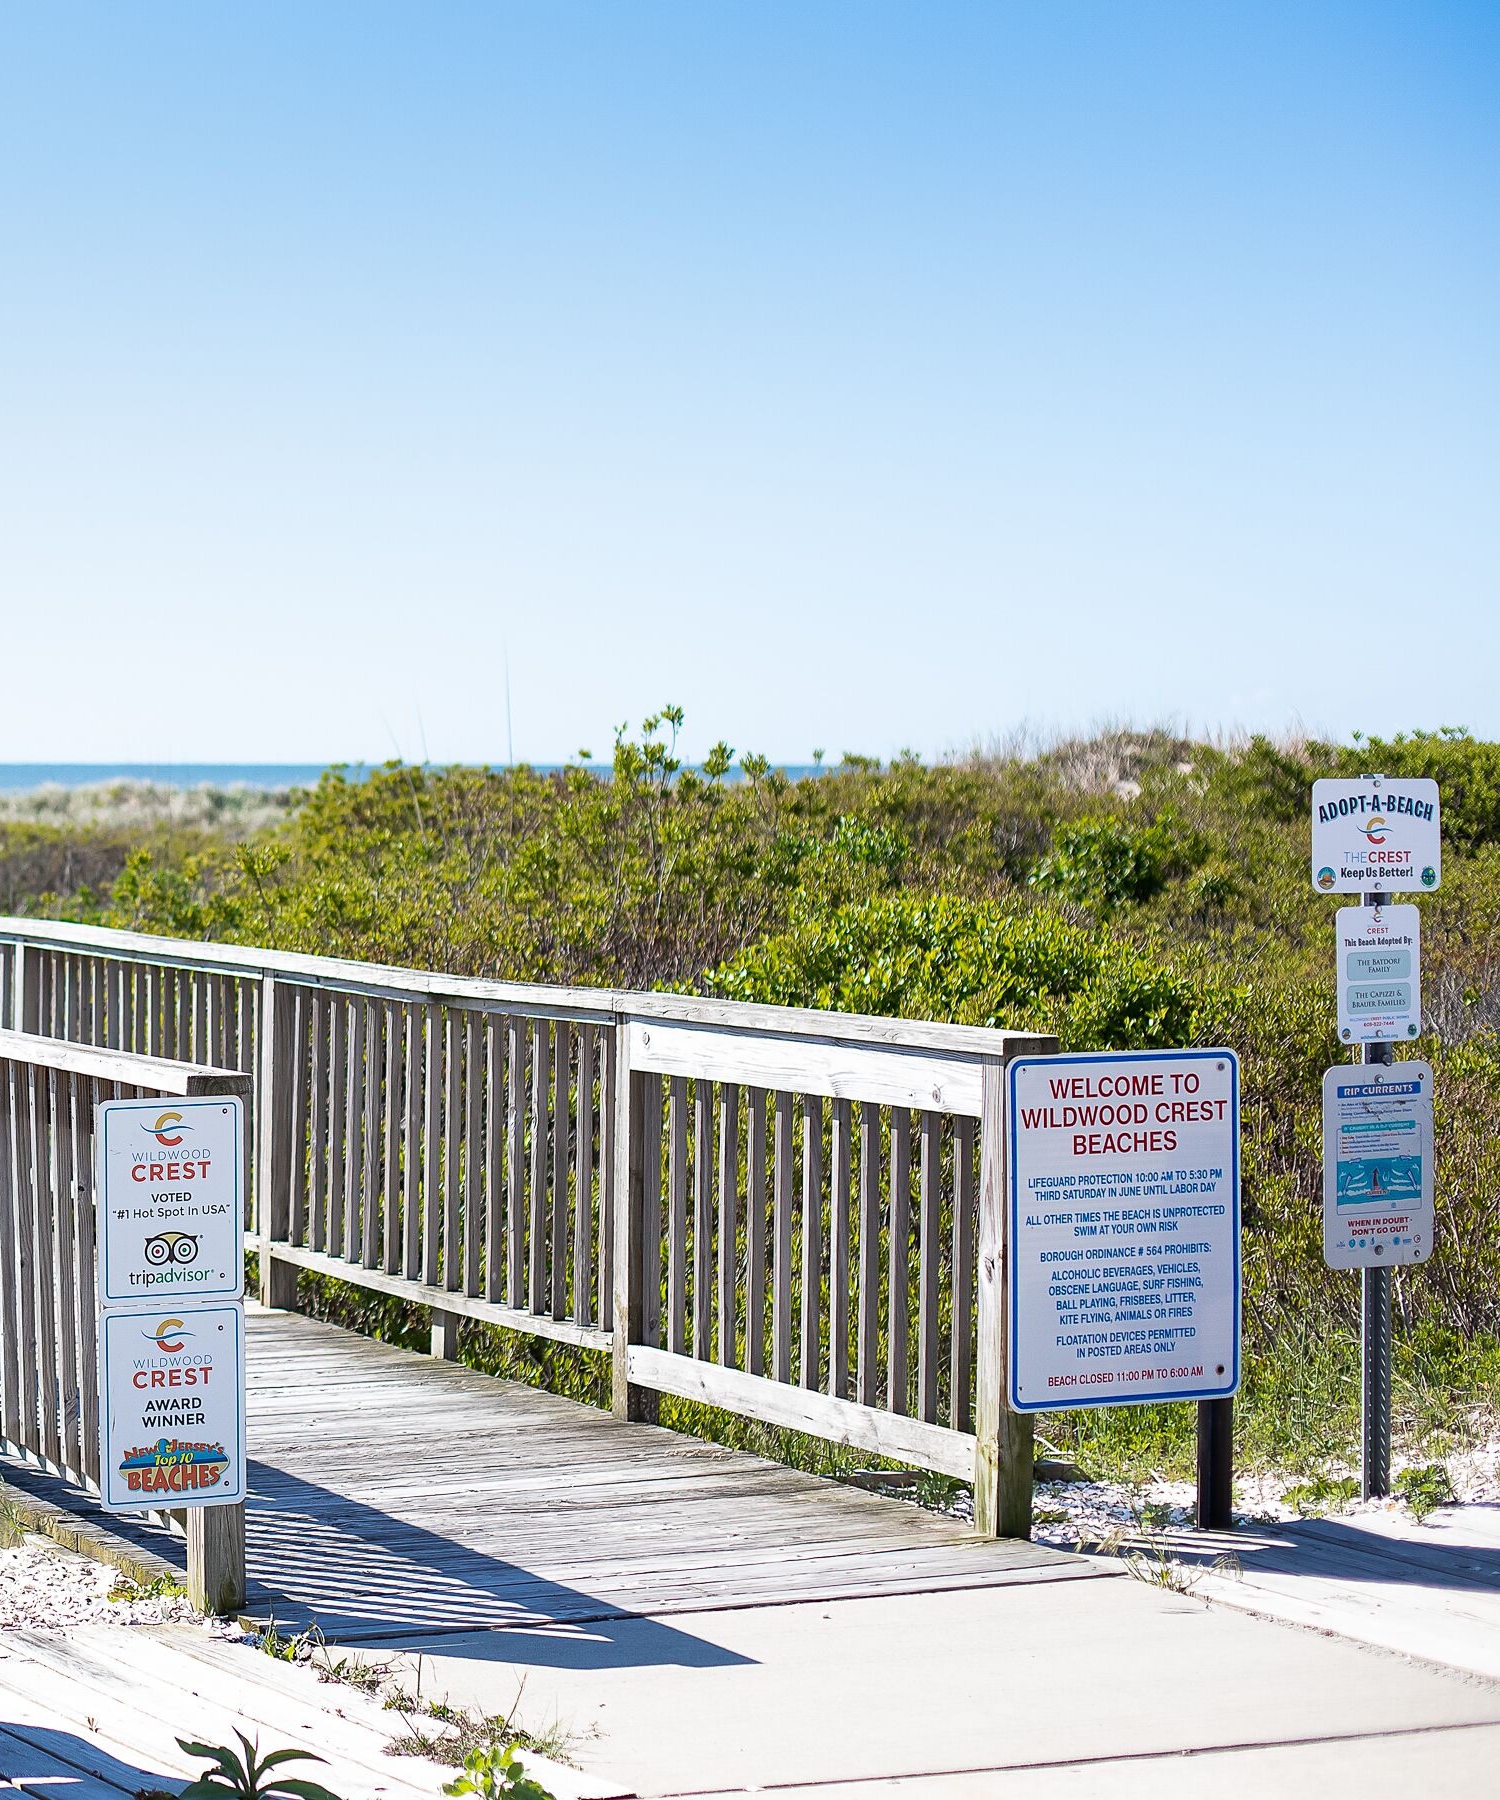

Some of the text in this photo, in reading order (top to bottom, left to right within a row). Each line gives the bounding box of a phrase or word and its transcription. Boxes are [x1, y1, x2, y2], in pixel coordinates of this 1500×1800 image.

[1319, 795, 1434, 822] ADOPT-A-BEACH
[1341, 866, 1413, 880] Keep Us Better!
[1345, 936, 1413, 947] This Beach Adopted By:
[1050, 1073, 1199, 1099] WELCOME TO
[1344, 1085, 1413, 1096] RIP CURRENTS
[1021, 1100, 1227, 1129] WILDWOOD CREST
[1074, 1131, 1177, 1155] BEACHES
[132, 1149, 211, 1162] WILDWOOD
[132, 1161, 211, 1182] CREST
[1029, 1169, 1222, 1188] LIFEGUARD PROTECTION 10:00 AM TO 5:30 PM
[151, 1192, 192, 1203] VOTED
[1035, 1182, 1216, 1201] THIRD SATURDAY IN JUNE UNTIL LABOR DAY
[133, 1209, 154, 1218] Hot
[158, 1206, 185, 1221] Spot
[188, 1206, 198, 1215] In
[1026, 1205, 1225, 1226] ALL OTHER TIMES THE BEACH IS UNPROTECTED
[1074, 1222, 1178, 1236] SWIM AT YOUR OWN RISK
[1041, 1243, 1212, 1262] BOROUGH ORDINANCE # 564 PROHIBITS:
[129, 1268, 209, 1287] tripadvisor
[1052, 1263, 1200, 1281] ALCOHOLIC BEVERAGES, VEHICLES,
[1049, 1277, 1203, 1296] OBSCENE LANGUAGE, SURF FISHING,
[1056, 1292, 1196, 1310] BALL PLAYING, FRISBEES, LITTER,
[1060, 1307, 1192, 1325] KITE FLYING, ANIMALS OR FIRES
[1057, 1327, 1195, 1346] FLOATATION DEVICES PERMITTED
[1077, 1342, 1175, 1358] IN POSTED AREAS ONLY
[133, 1355, 212, 1368] WILDWOOD
[133, 1367, 212, 1389] CREST
[1049, 1366, 1203, 1386] BEACH CLOSED 11:00 PM TO 6:00 AM
[145, 1398, 202, 1412] AWARD
[142, 1413, 205, 1428] WINNER
[124, 1439, 224, 1462] NEW JERSEY'S
[155, 1452, 194, 1467] Top 10
[128, 1465, 220, 1493] BEACHES
